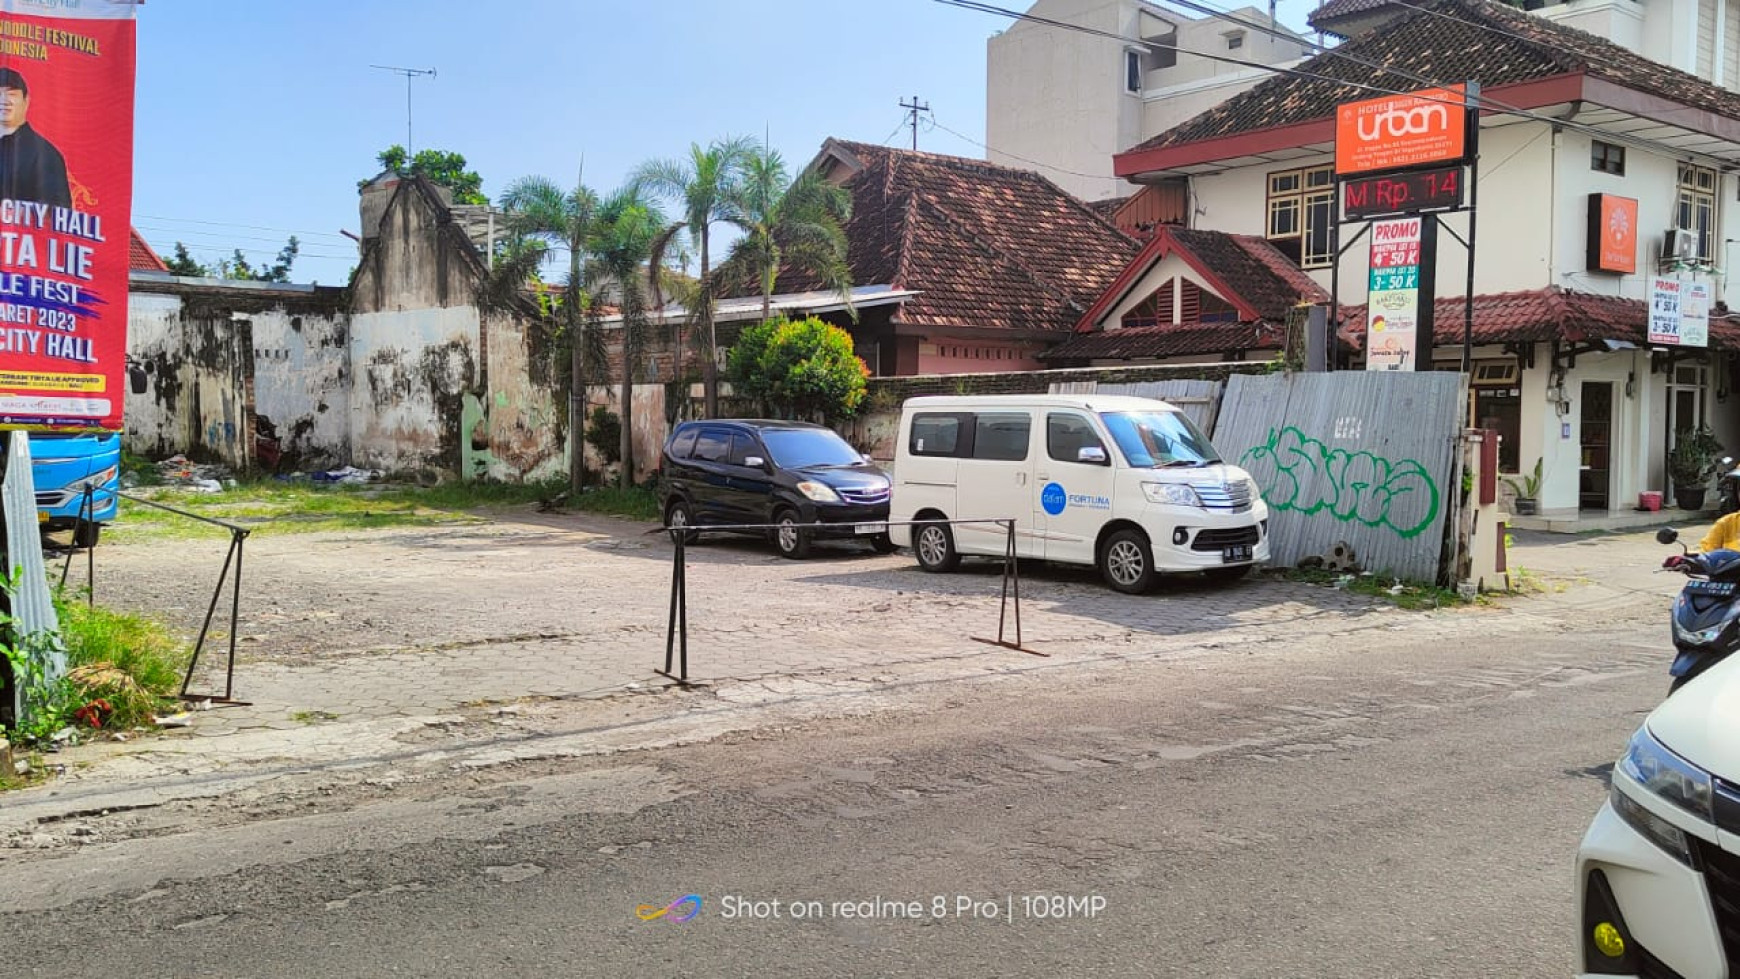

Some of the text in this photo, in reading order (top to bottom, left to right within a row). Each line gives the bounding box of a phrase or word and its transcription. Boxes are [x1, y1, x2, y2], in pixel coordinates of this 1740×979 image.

[45, 27, 100, 56] FESTIVAL
[1358, 103, 1389, 115] HOTEL
[1358, 102, 1447, 140] urban
[1376, 179, 1415, 209] Rp.
[2, 198, 106, 241] CITY HALL
[1376, 221, 1418, 240] PROMO
[2, 231, 93, 280] TA LIE
[1390, 251, 1404, 265] 50
[1407, 249, 1417, 264] K
[30, 276, 82, 304] FEST
[1389, 275, 1403, 289] 50
[1406, 275, 1416, 288] K
[38, 307, 76, 332] 2023
[47, 333, 99, 363] HALL
[1069, 495, 1109, 505] FORTUNA
